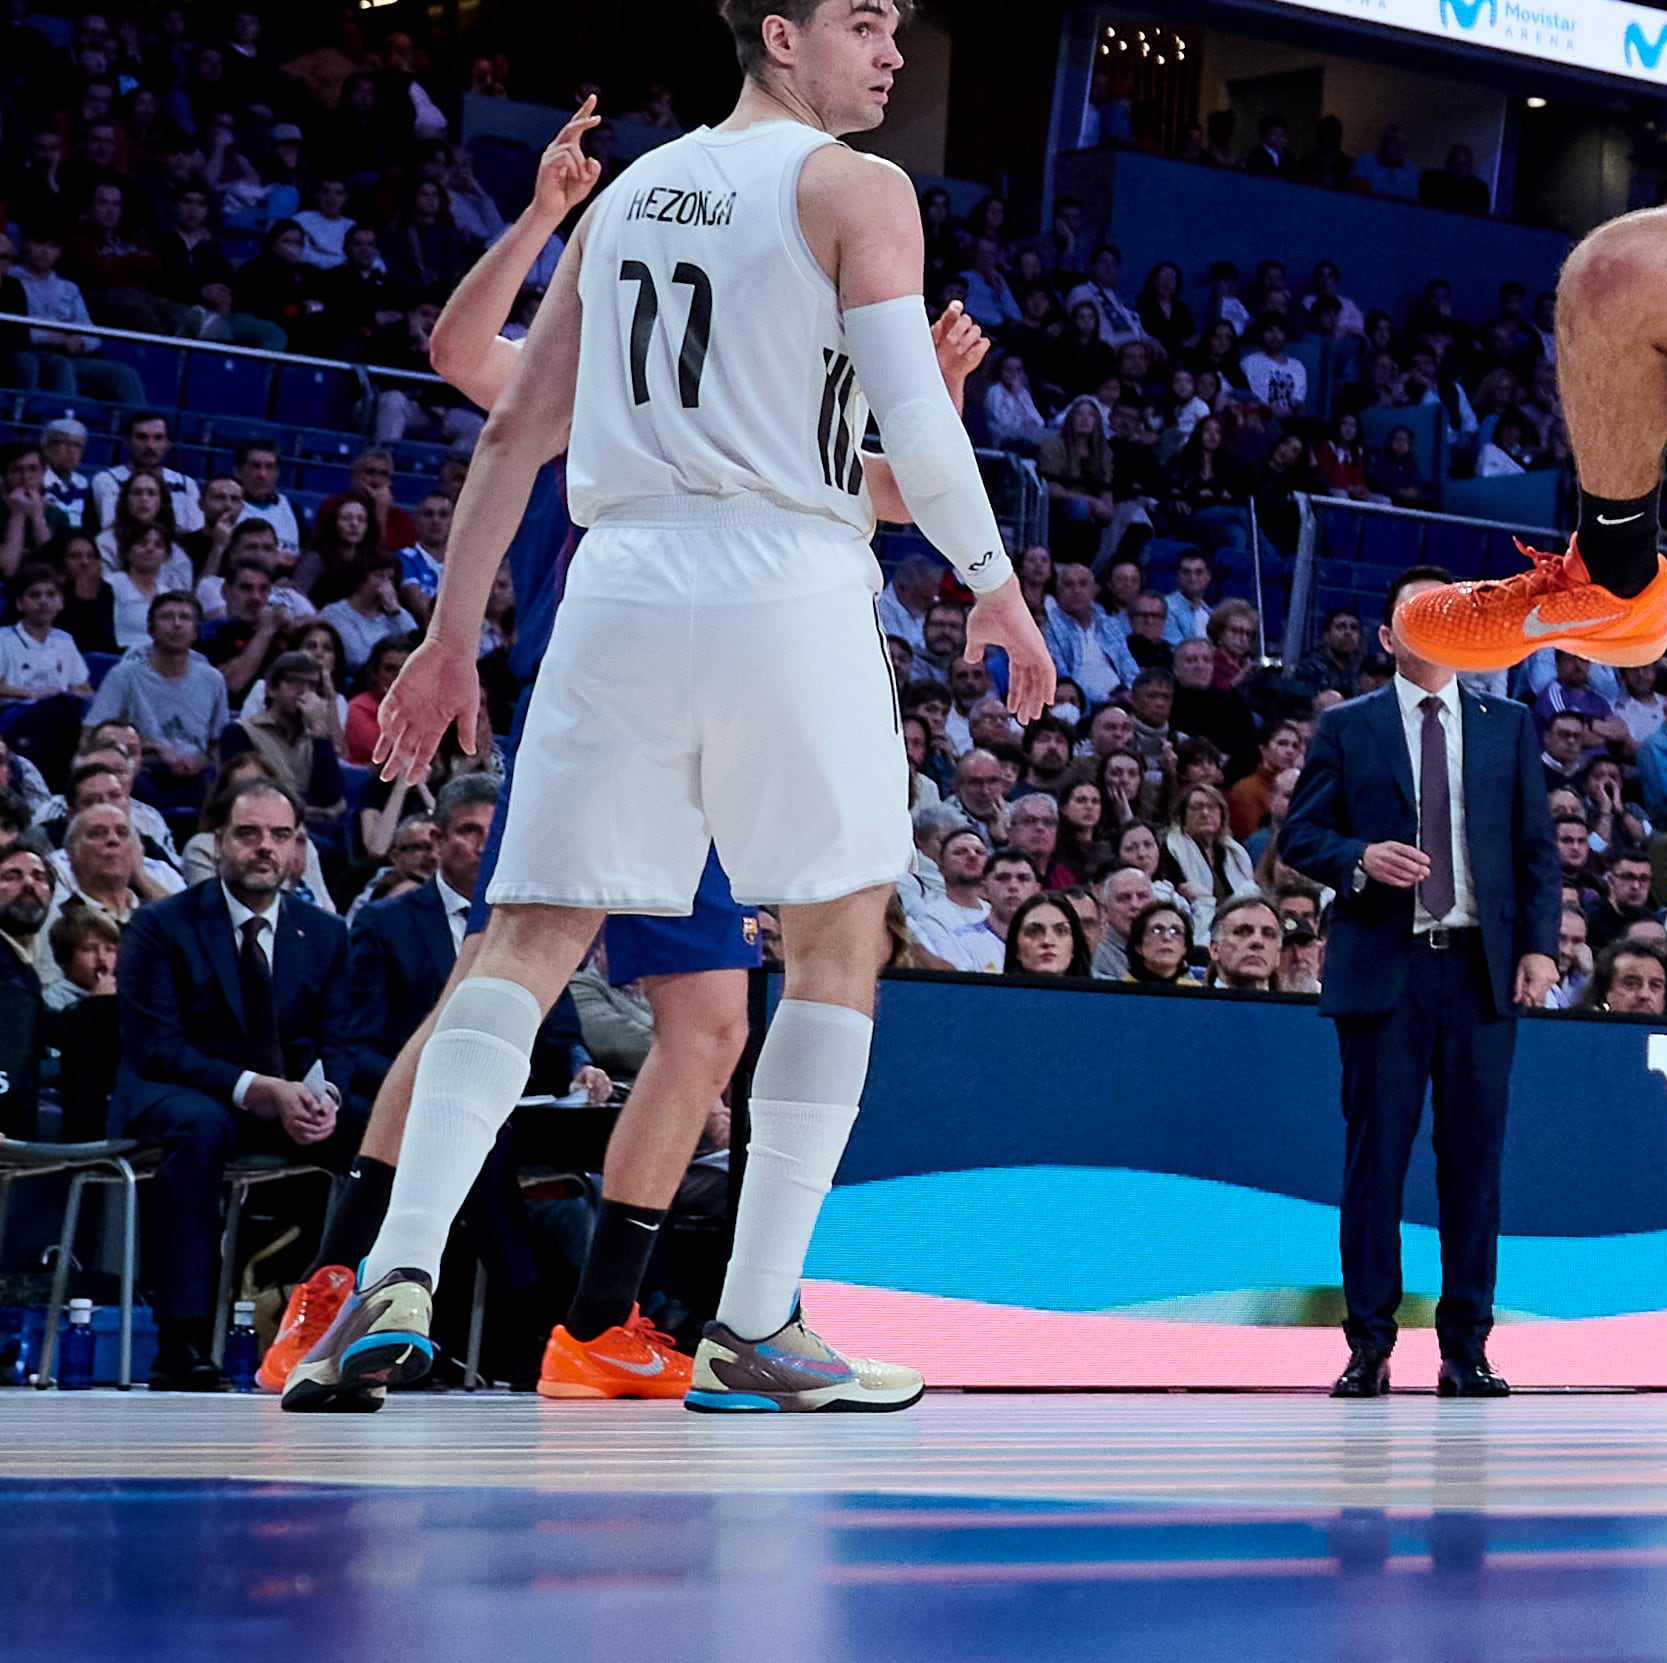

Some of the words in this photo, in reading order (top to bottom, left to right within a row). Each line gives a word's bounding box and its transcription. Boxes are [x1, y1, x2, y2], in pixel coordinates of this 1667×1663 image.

[1505, 1, 1578, 34] Movistar
[1506, 25, 1575, 51] ARENA
[627, 187, 737, 226] HEZONJA
[620, 260, 713, 408] 11
